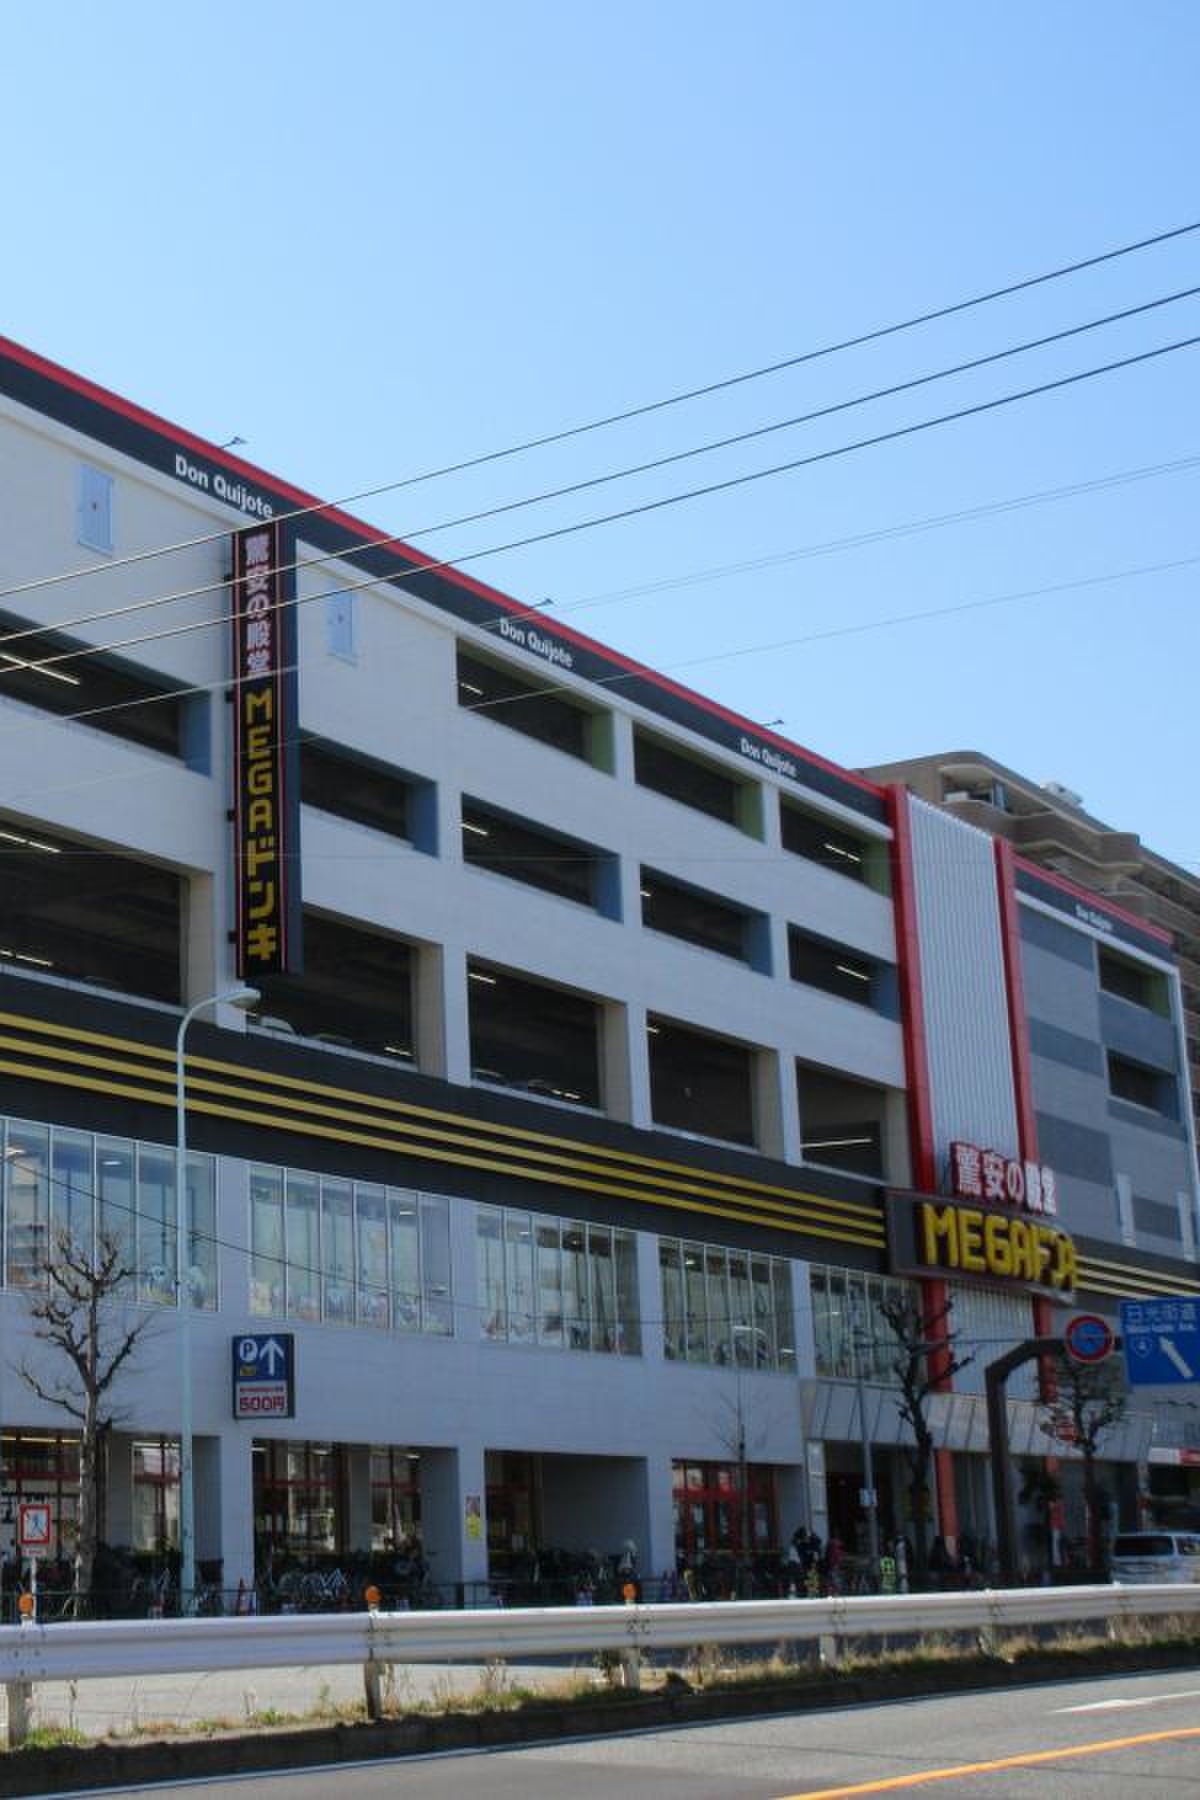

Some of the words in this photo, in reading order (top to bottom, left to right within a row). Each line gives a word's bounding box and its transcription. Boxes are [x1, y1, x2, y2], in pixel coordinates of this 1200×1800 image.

[175, 453, 209, 489] Don
[213, 474, 273, 519] Quijote
[246, 687, 276, 961] MEGAドンキ
